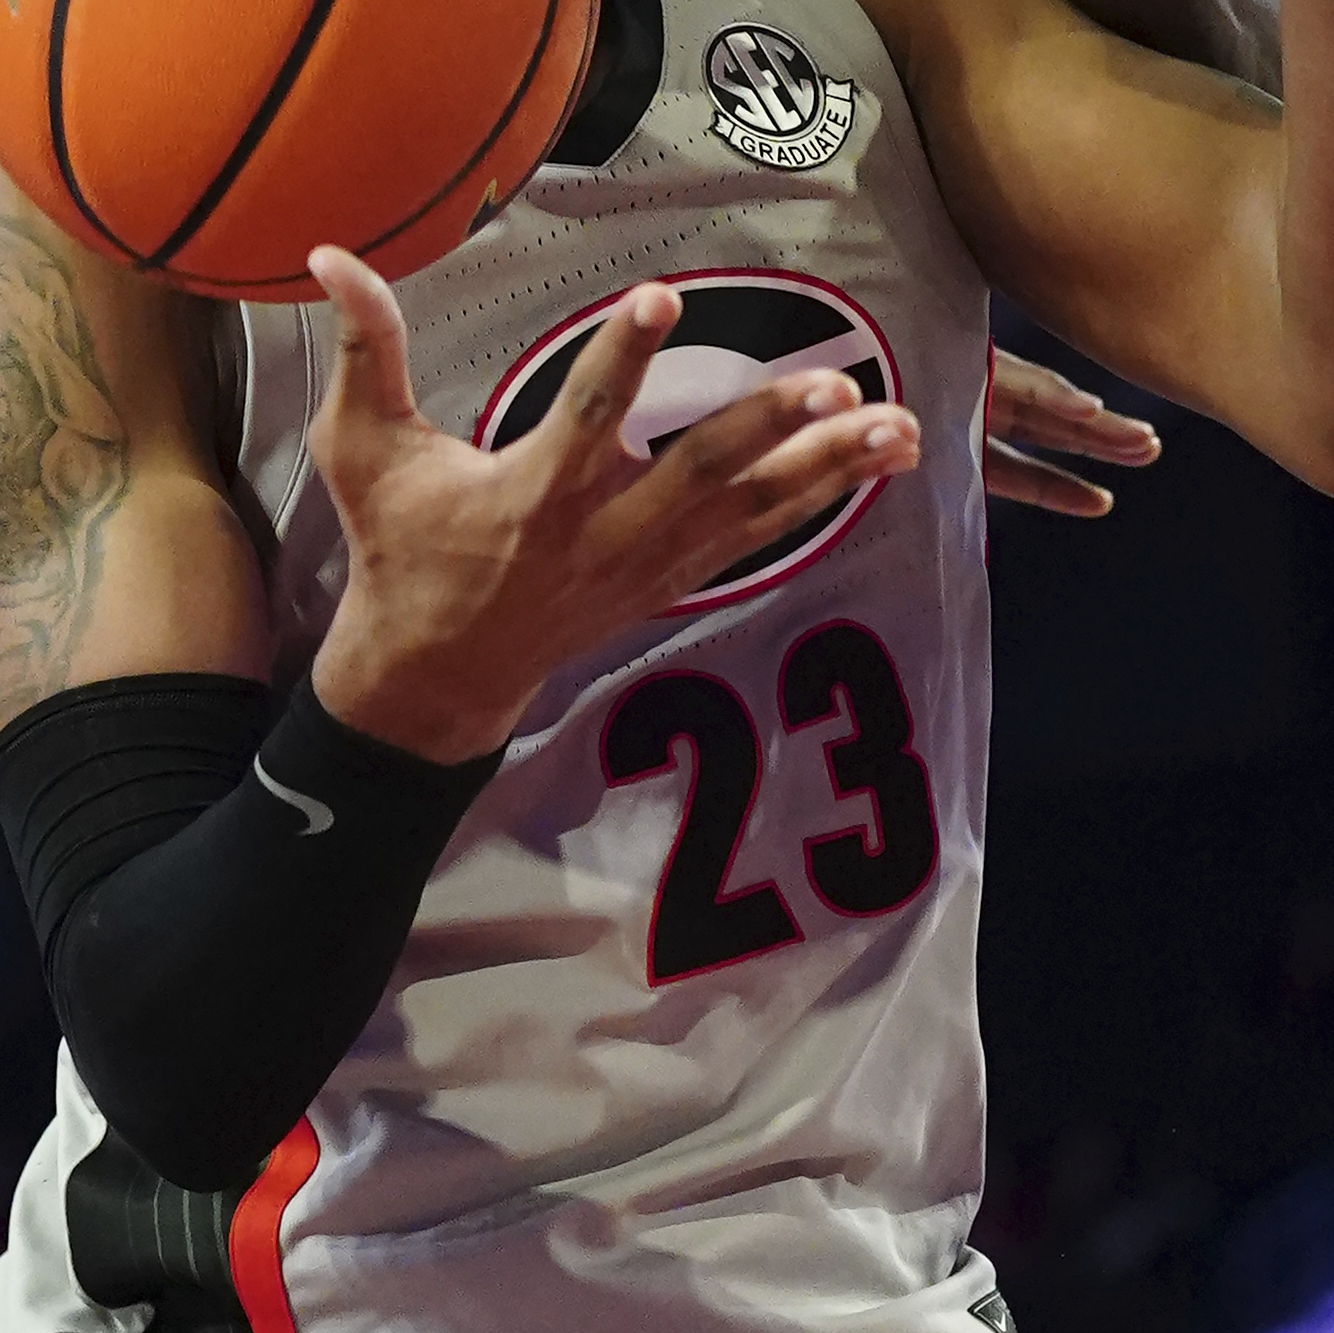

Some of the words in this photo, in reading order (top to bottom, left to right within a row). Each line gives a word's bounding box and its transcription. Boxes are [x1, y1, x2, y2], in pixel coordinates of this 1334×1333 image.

[710, 29, 816, 133] SEC
[740, 109, 847, 166] GRADUATE
[600, 619, 940, 989] 23
